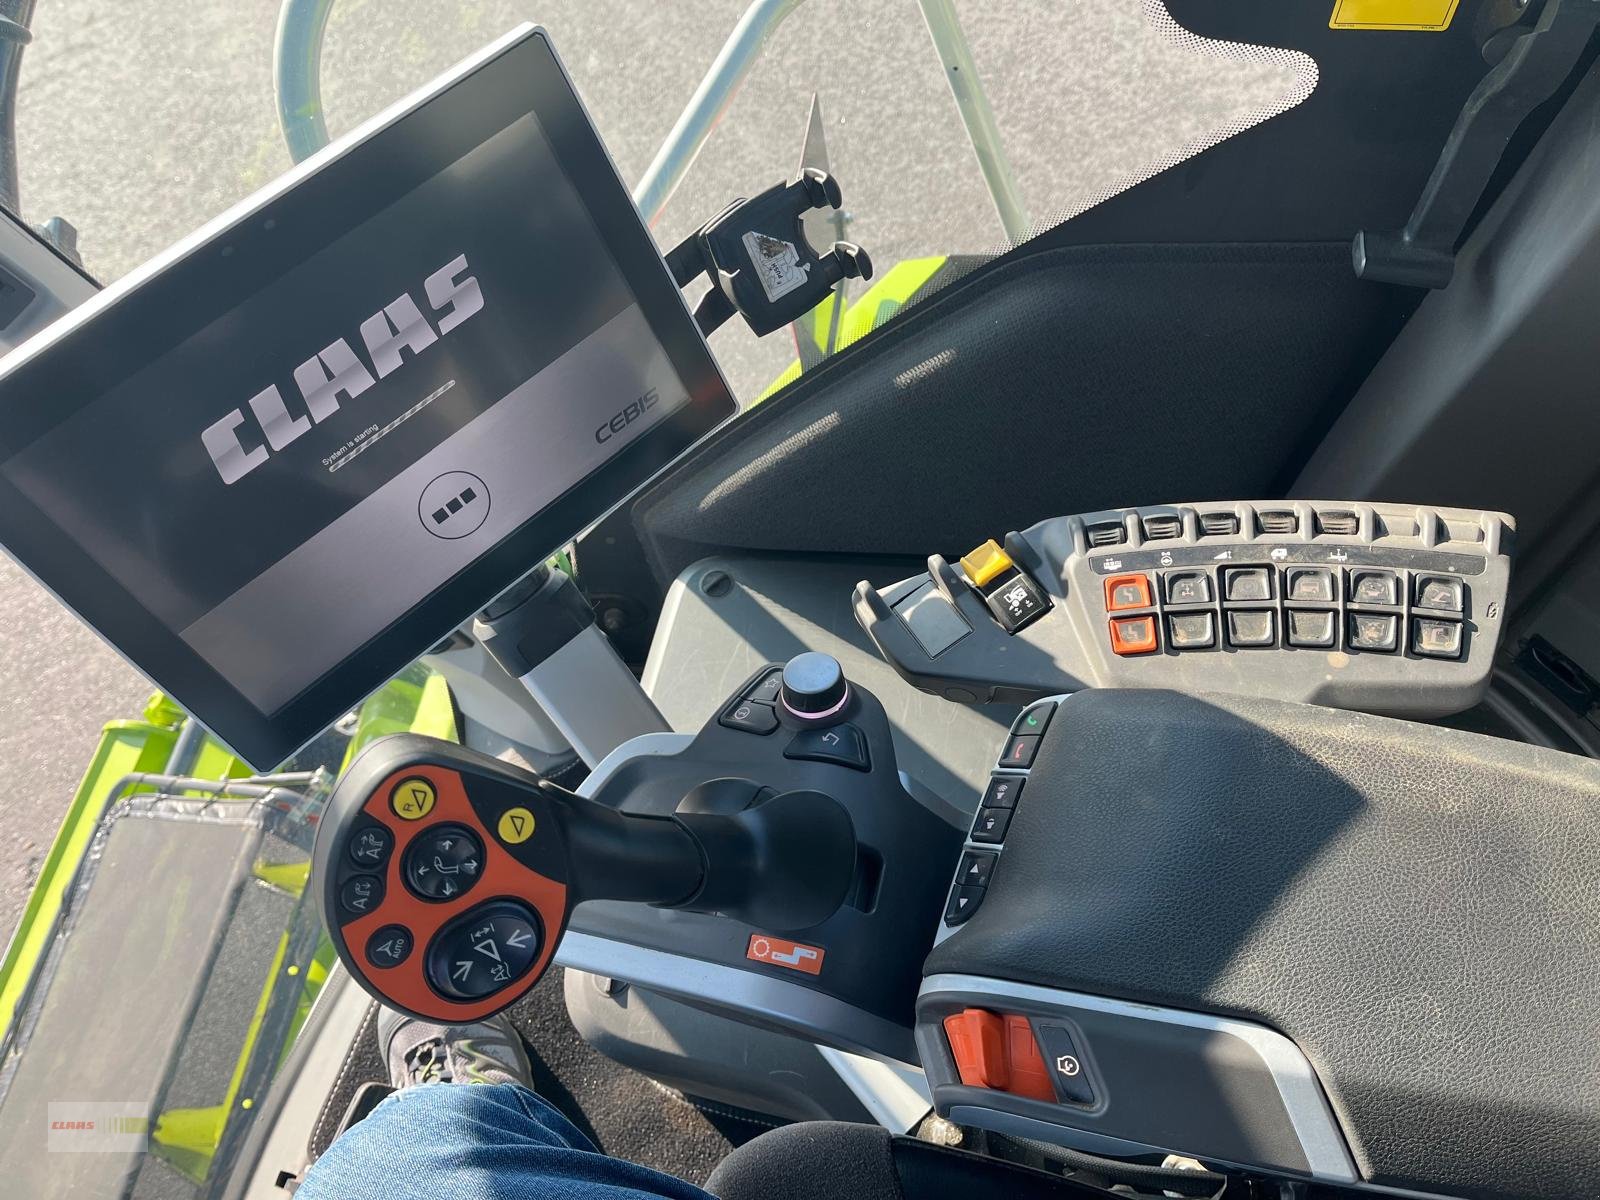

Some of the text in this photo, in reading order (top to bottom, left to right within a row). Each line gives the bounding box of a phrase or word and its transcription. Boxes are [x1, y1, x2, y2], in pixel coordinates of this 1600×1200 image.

[201, 253, 485, 485] CLAAS
[595, 386, 659, 444] CEBIS
[322, 423, 379, 466] System is starting
[402, 803, 415, 812] R
[366, 847, 382, 860] A
[352, 898, 369, 910] A
[392, 938, 405, 959] AUTO
